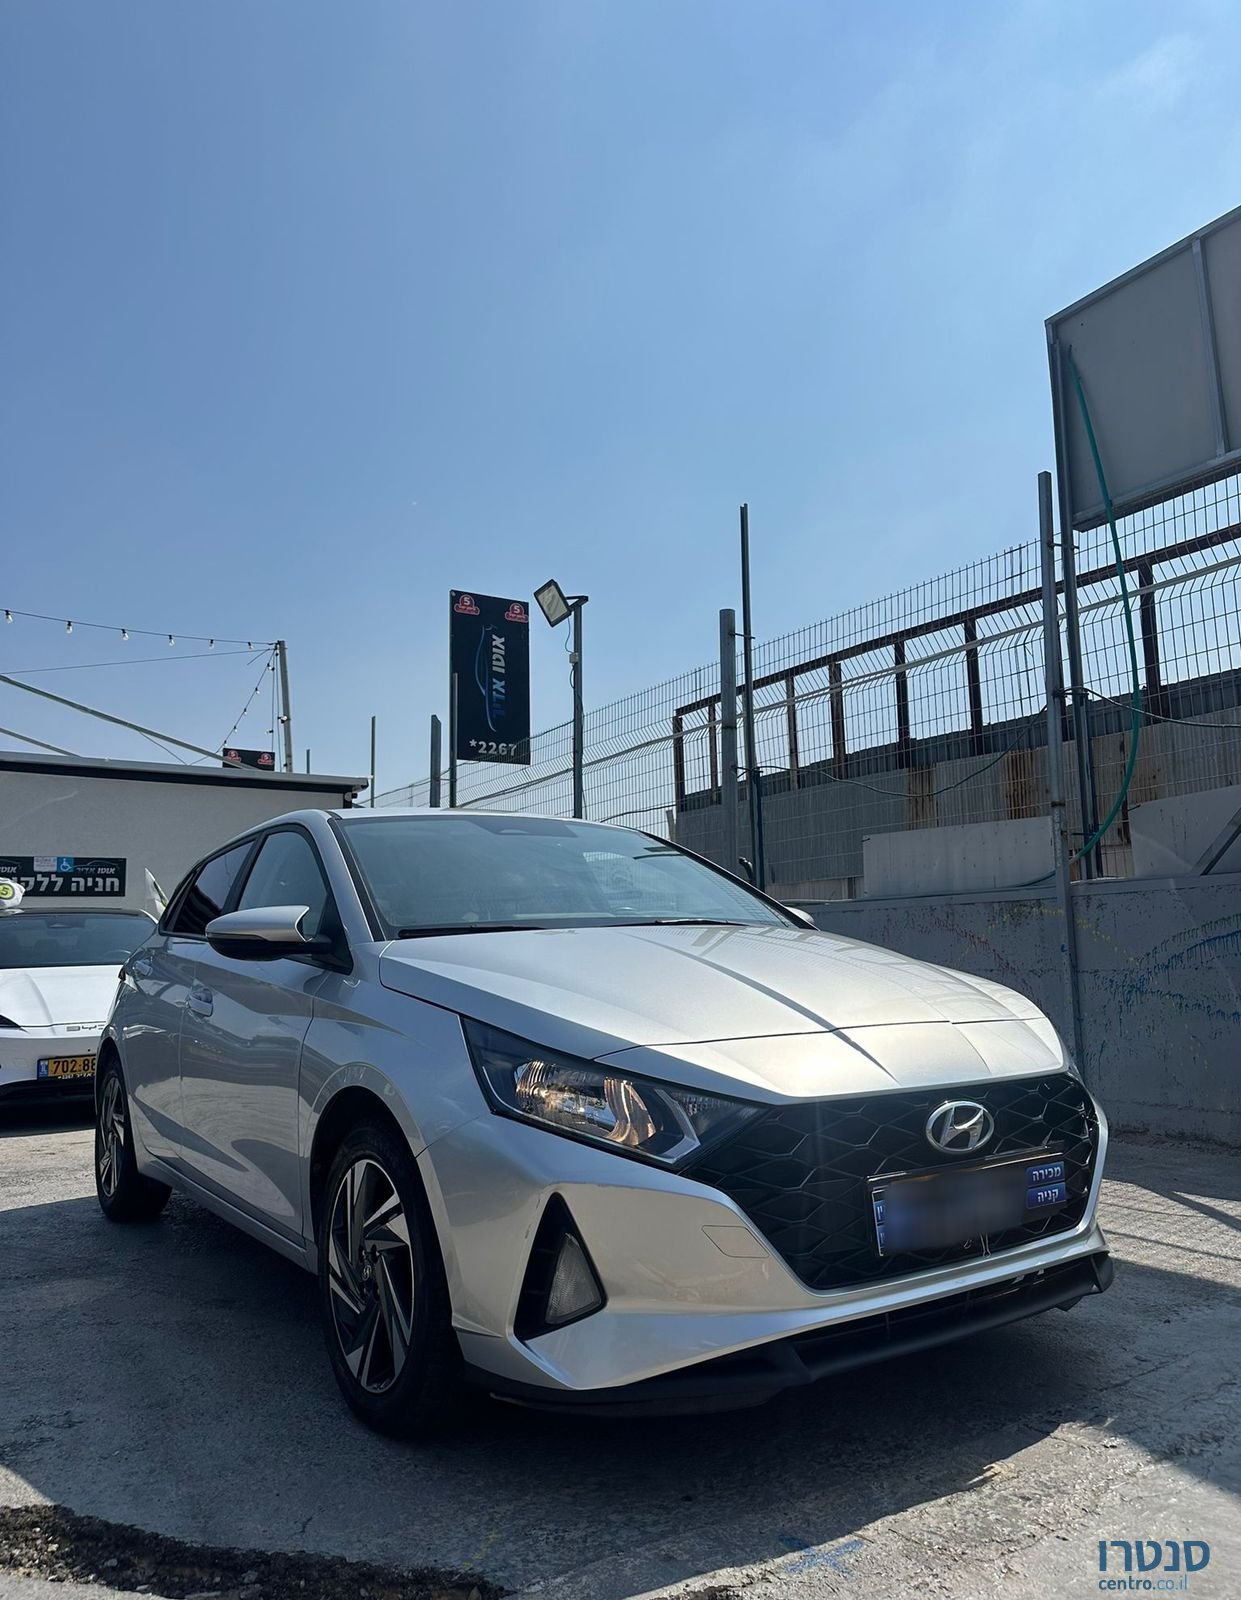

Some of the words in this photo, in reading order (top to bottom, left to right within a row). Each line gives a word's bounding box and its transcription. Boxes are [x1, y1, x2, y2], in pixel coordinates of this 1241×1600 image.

[492, 634, 506, 674] אוטו
[71, 877, 120, 892] חניה
[1032, 1166, 1062, 1182] מכירה
[1037, 1188, 1059, 1203] קניה
